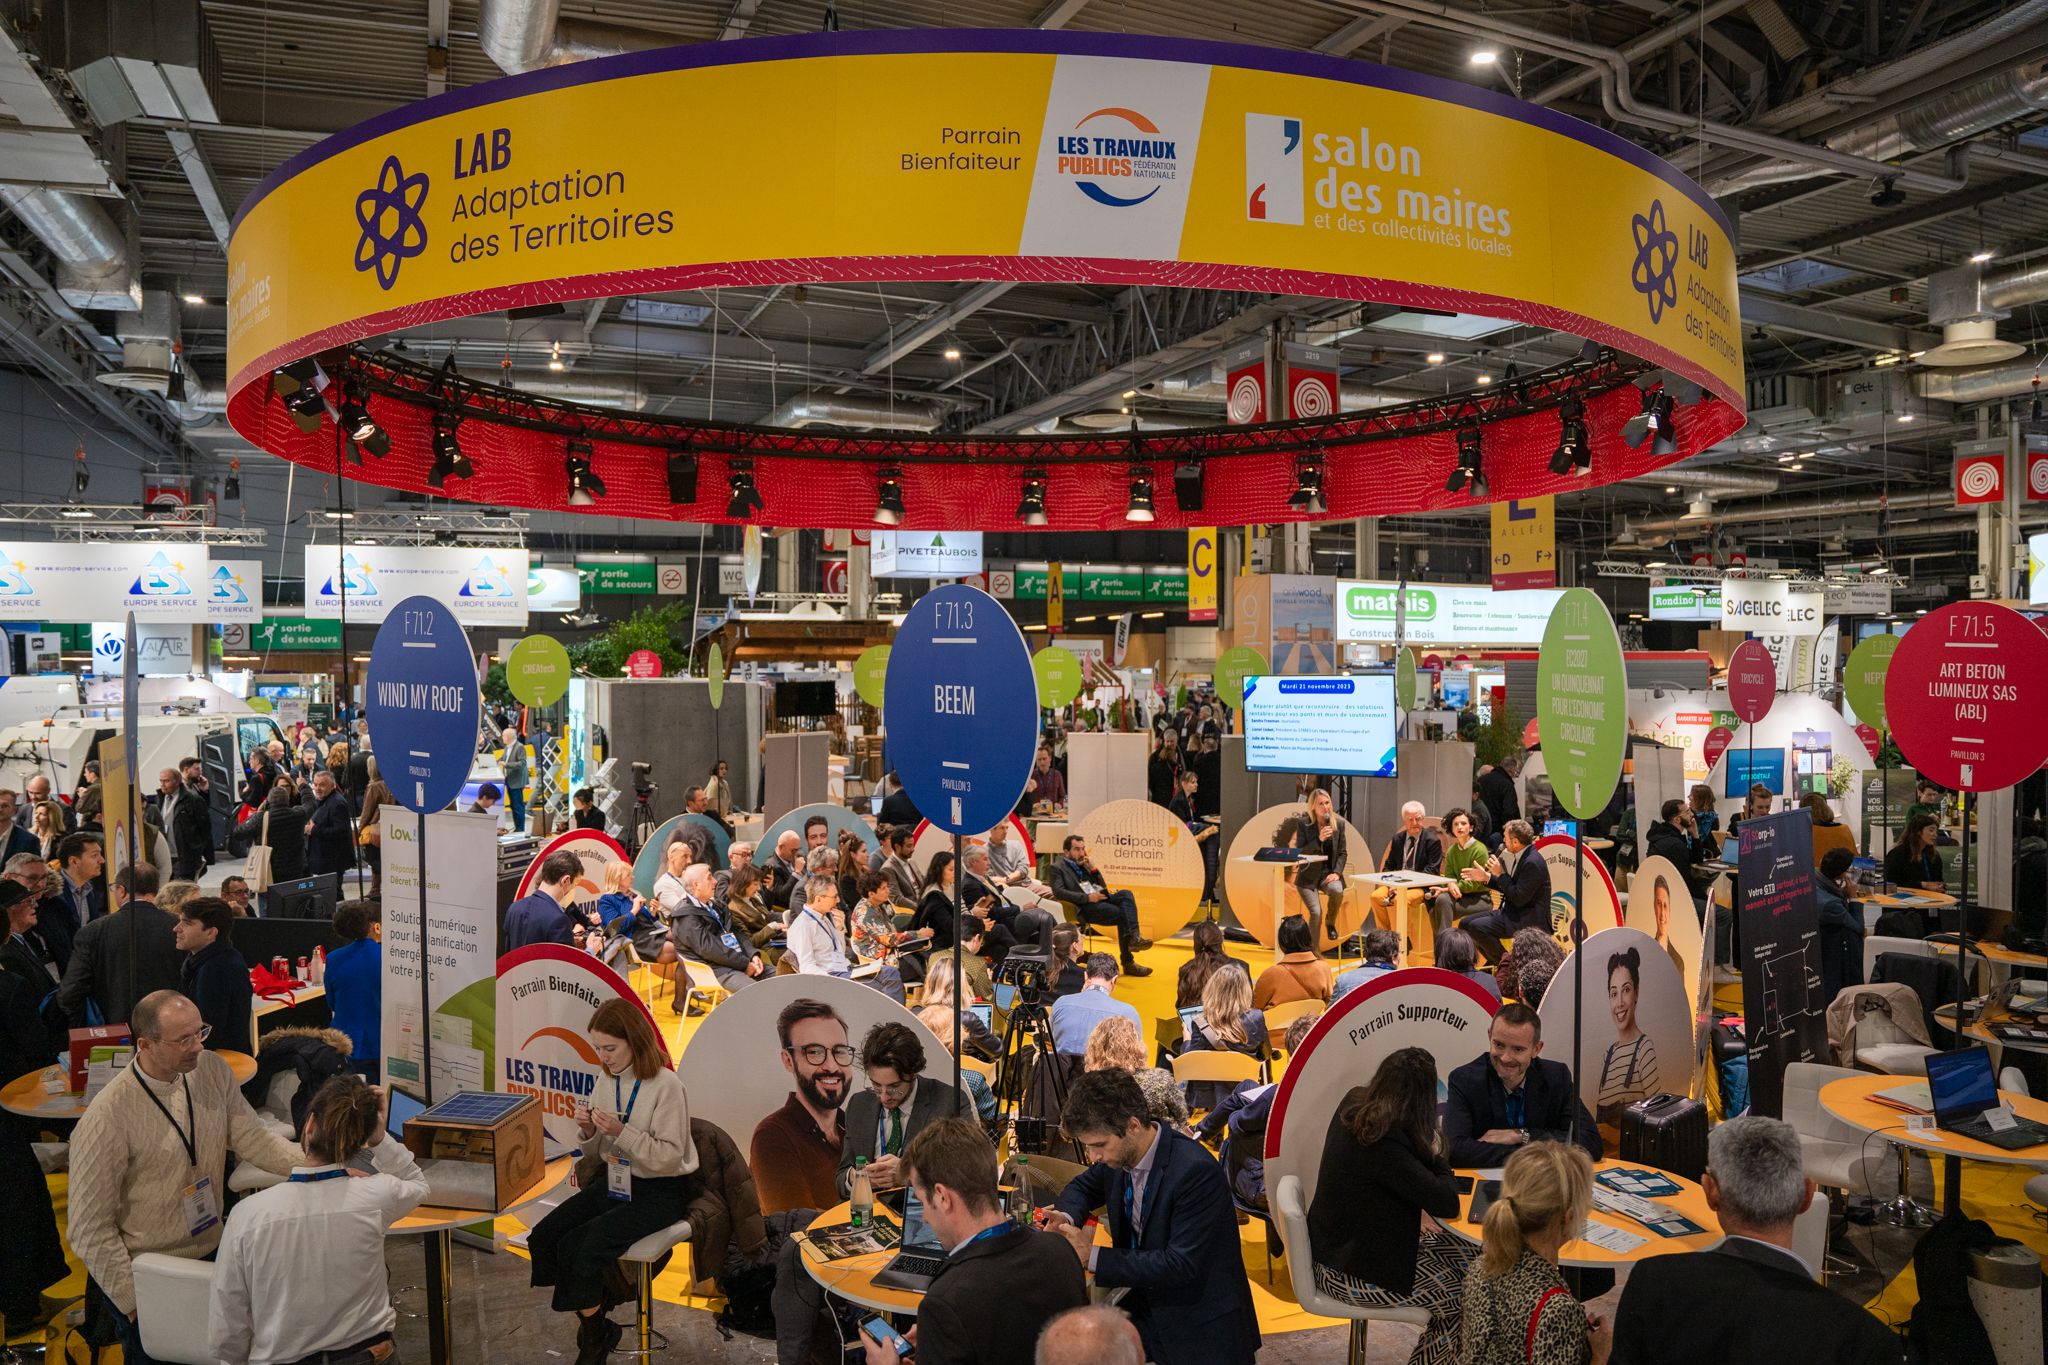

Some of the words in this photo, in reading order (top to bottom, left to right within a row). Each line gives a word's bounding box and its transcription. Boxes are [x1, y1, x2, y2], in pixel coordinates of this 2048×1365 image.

[941, 127, 1021, 144] Parrain
[453, 128, 511, 180] LAB
[1058, 136, 1089, 155] LES
[1093, 137, 1177, 160] TRAVAUX
[1313, 127, 1421, 177] salon
[901, 151, 1021, 170] Bienfaiteur
[1058, 156, 1132, 177] PUBLICS
[1134, 159, 1177, 171] FÉDÉRATION
[1134, 170, 1177, 180] NATIONALE
[451, 169, 626, 222] Adaptation
[1314, 167, 1382, 214] des
[1397, 188, 1511, 238] maires
[450, 234, 503, 264] des
[510, 208, 675, 253] Territoires
[1314, 213, 1331, 230] et
[1338, 214, 1366, 234] des
[1372, 220, 1462, 248] collectivités
[1467, 232, 1513, 257] locales
[1688, 224, 1708, 270] LAB
[1687, 273, 1732, 327] Adaptation
[1686, 310, 1703, 340] des
[1704, 319, 1738, 368] Territoires
[898, 547, 978, 557] PIVETEAUBOIS
[1192, 538, 1212, 577] C
[1502, 553, 1511, 566] D
[1536, 550, 1543, 563] F
[601, 569, 628, 577] sortie
[724, 571, 743, 581] WC
[601, 579, 613, 588] de
[1036, 586, 1046, 595] de
[1050, 576, 1061, 604] A
[1101, 579, 1124, 587] sortie
[1164, 580, 1185, 588] sortie
[1101, 588, 1111, 596] de
[1113, 589, 1141, 597] secours
[1164, 589, 1173, 597] de
[1, 599, 41, 607] SERVICE
[123, 599, 159, 607] EUROPE
[315, 599, 346, 607] EUROP
[349, 599, 384, 607] SERVICE
[1353, 594, 1430, 613] matis
[1727, 600, 1782, 616] SAGELEC
[405, 612, 411, 635] F
[413, 611, 434, 635] 71.2
[935, 602, 942, 629] F
[945, 602, 974, 629] 71.3
[1564, 602, 1570, 625] F
[1571, 603, 1588, 627] 71.4
[281, 623, 312, 632] sortie
[1350, 629, 1411, 639] Construcn
[1414, 629, 1435, 639] Bois
[1950, 616, 1958, 638] F
[1963, 616, 1995, 638] 71.5
[281, 634, 295, 644] de
[1741, 673, 1765, 685] TRICYCLE
[1864, 672, 1886, 685] NEPT
[1939, 663, 1962, 679] ART
[1966, 664, 2006, 680] BETON
[1552, 673, 1561, 691] UN
[377, 682, 408, 707] WIND
[410, 684, 429, 710] MY
[432, 685, 464, 712] ROOF
[934, 684, 975, 715] BEEM
[1929, 682, 1989, 700] LUMINEUX
[1992, 684, 2017, 702] SAS
[1551, 697, 1569, 716] POUR
[1955, 703, 1988, 723] (ABL)
[1560, 722, 1596, 745] CIRCULAIRE
[1950, 750, 1979, 761] PAVILLON
[1980, 752, 1985, 761] 3
[942, 778, 966, 791] PAVILLON
[966, 780, 971, 792] 3
[1095, 834, 1163, 848] Anticipons
[574, 850, 608, 865] Bienfaiteur
[1113, 848, 1163, 860] demain
[390, 863, 420, 875] Répondr
[390, 875, 412, 887] Décret
[413, 879, 441, 890] Teaire
[1748, 887, 1764, 899] Votre
[1764, 883, 1776, 896] GTB
[390, 909, 421, 926] Solutio
[427, 918, 478, 936] numérique
[390, 930, 410, 942] pour
[412, 931, 421, 944] la
[427, 933, 478, 953] lanification
[389, 944, 443, 966] énergéque
[444, 955, 457, 968] de
[389, 964, 413, 978] votre
[415, 969, 435, 982] pc
[510, 977, 546, 1001] Parrain
[549, 975, 601, 1010] Bienfaite
[1348, 1011, 1394, 1046] Parrain
[1397, 1003, 1469, 1032] Supporteur
[506, 1057, 535, 1085] LES
[537, 1063, 602, 1097] TRAVA
